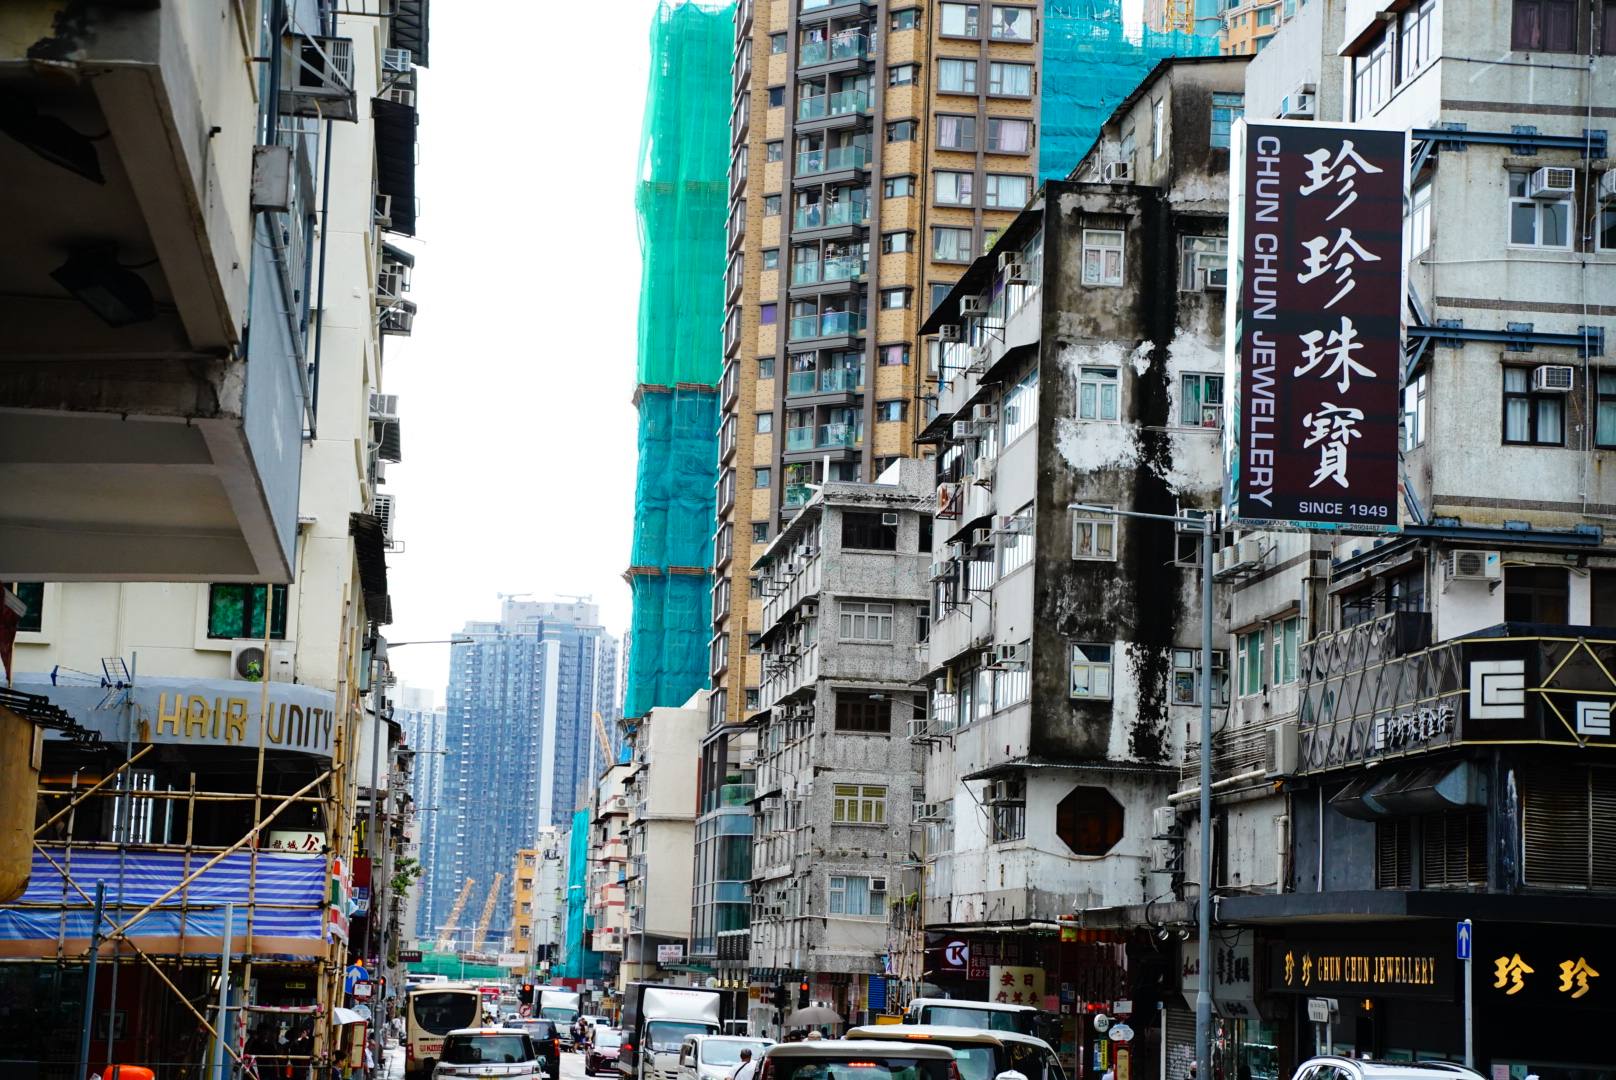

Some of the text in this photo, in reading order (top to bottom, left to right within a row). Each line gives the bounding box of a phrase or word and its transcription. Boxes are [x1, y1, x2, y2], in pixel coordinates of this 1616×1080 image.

[1249, 135, 1281, 508] CHUN CHUN JEWELLERY
[1294, 139, 1384, 489] 珍珍珠寶
[1299, 501, 1389, 518] SINCE 1949
[156, 692, 333, 750] HAIR UNITY
[1317, 956, 1435, 985] CHUN CHUN JEWELLERY
[1098, 1019, 1108, 1028] 25A
